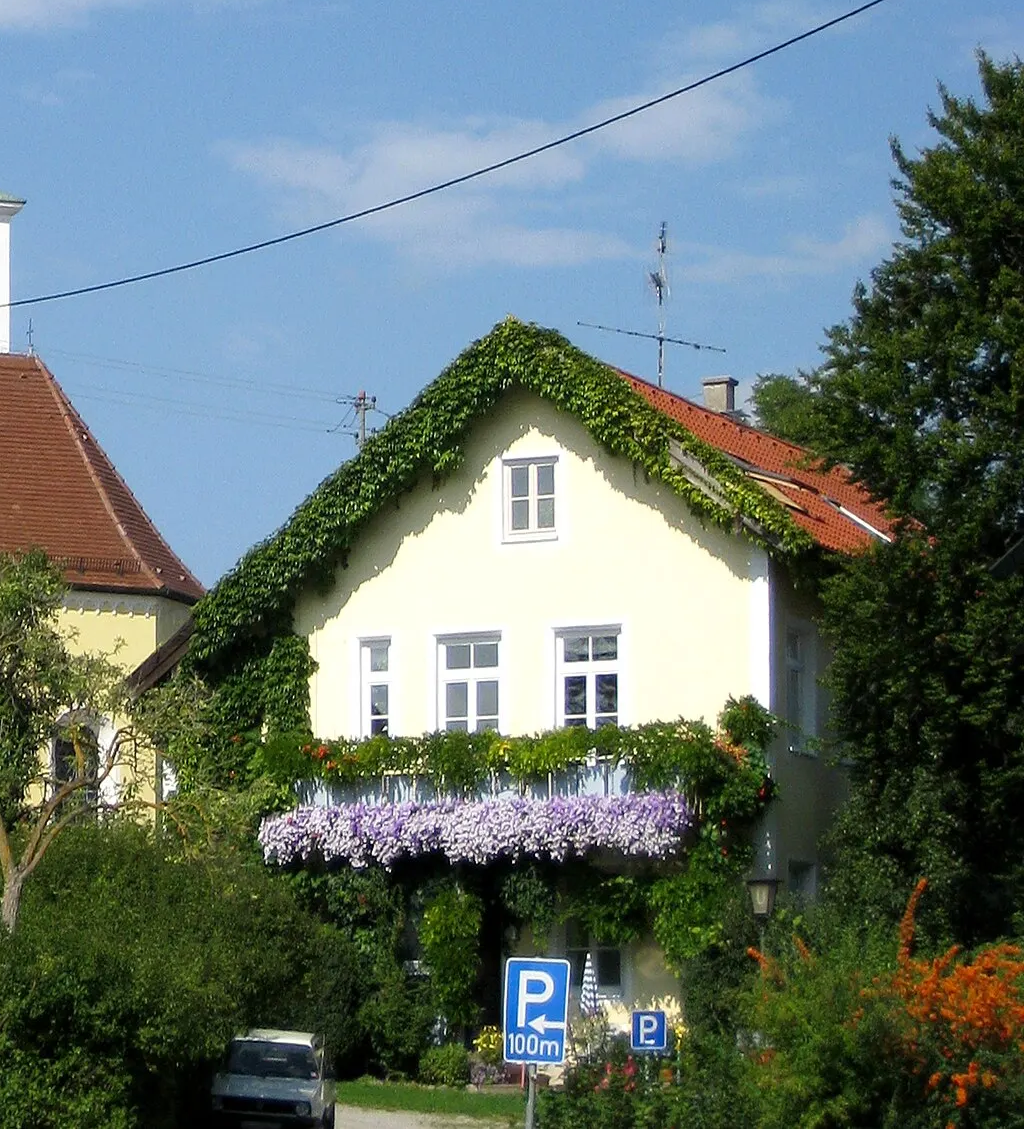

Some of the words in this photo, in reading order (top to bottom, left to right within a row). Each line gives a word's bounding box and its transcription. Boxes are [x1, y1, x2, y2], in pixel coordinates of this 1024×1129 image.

[517, 970, 554, 1027] P
[640, 1015, 658, 1044] P
[508, 1033, 559, 1056] 100m
